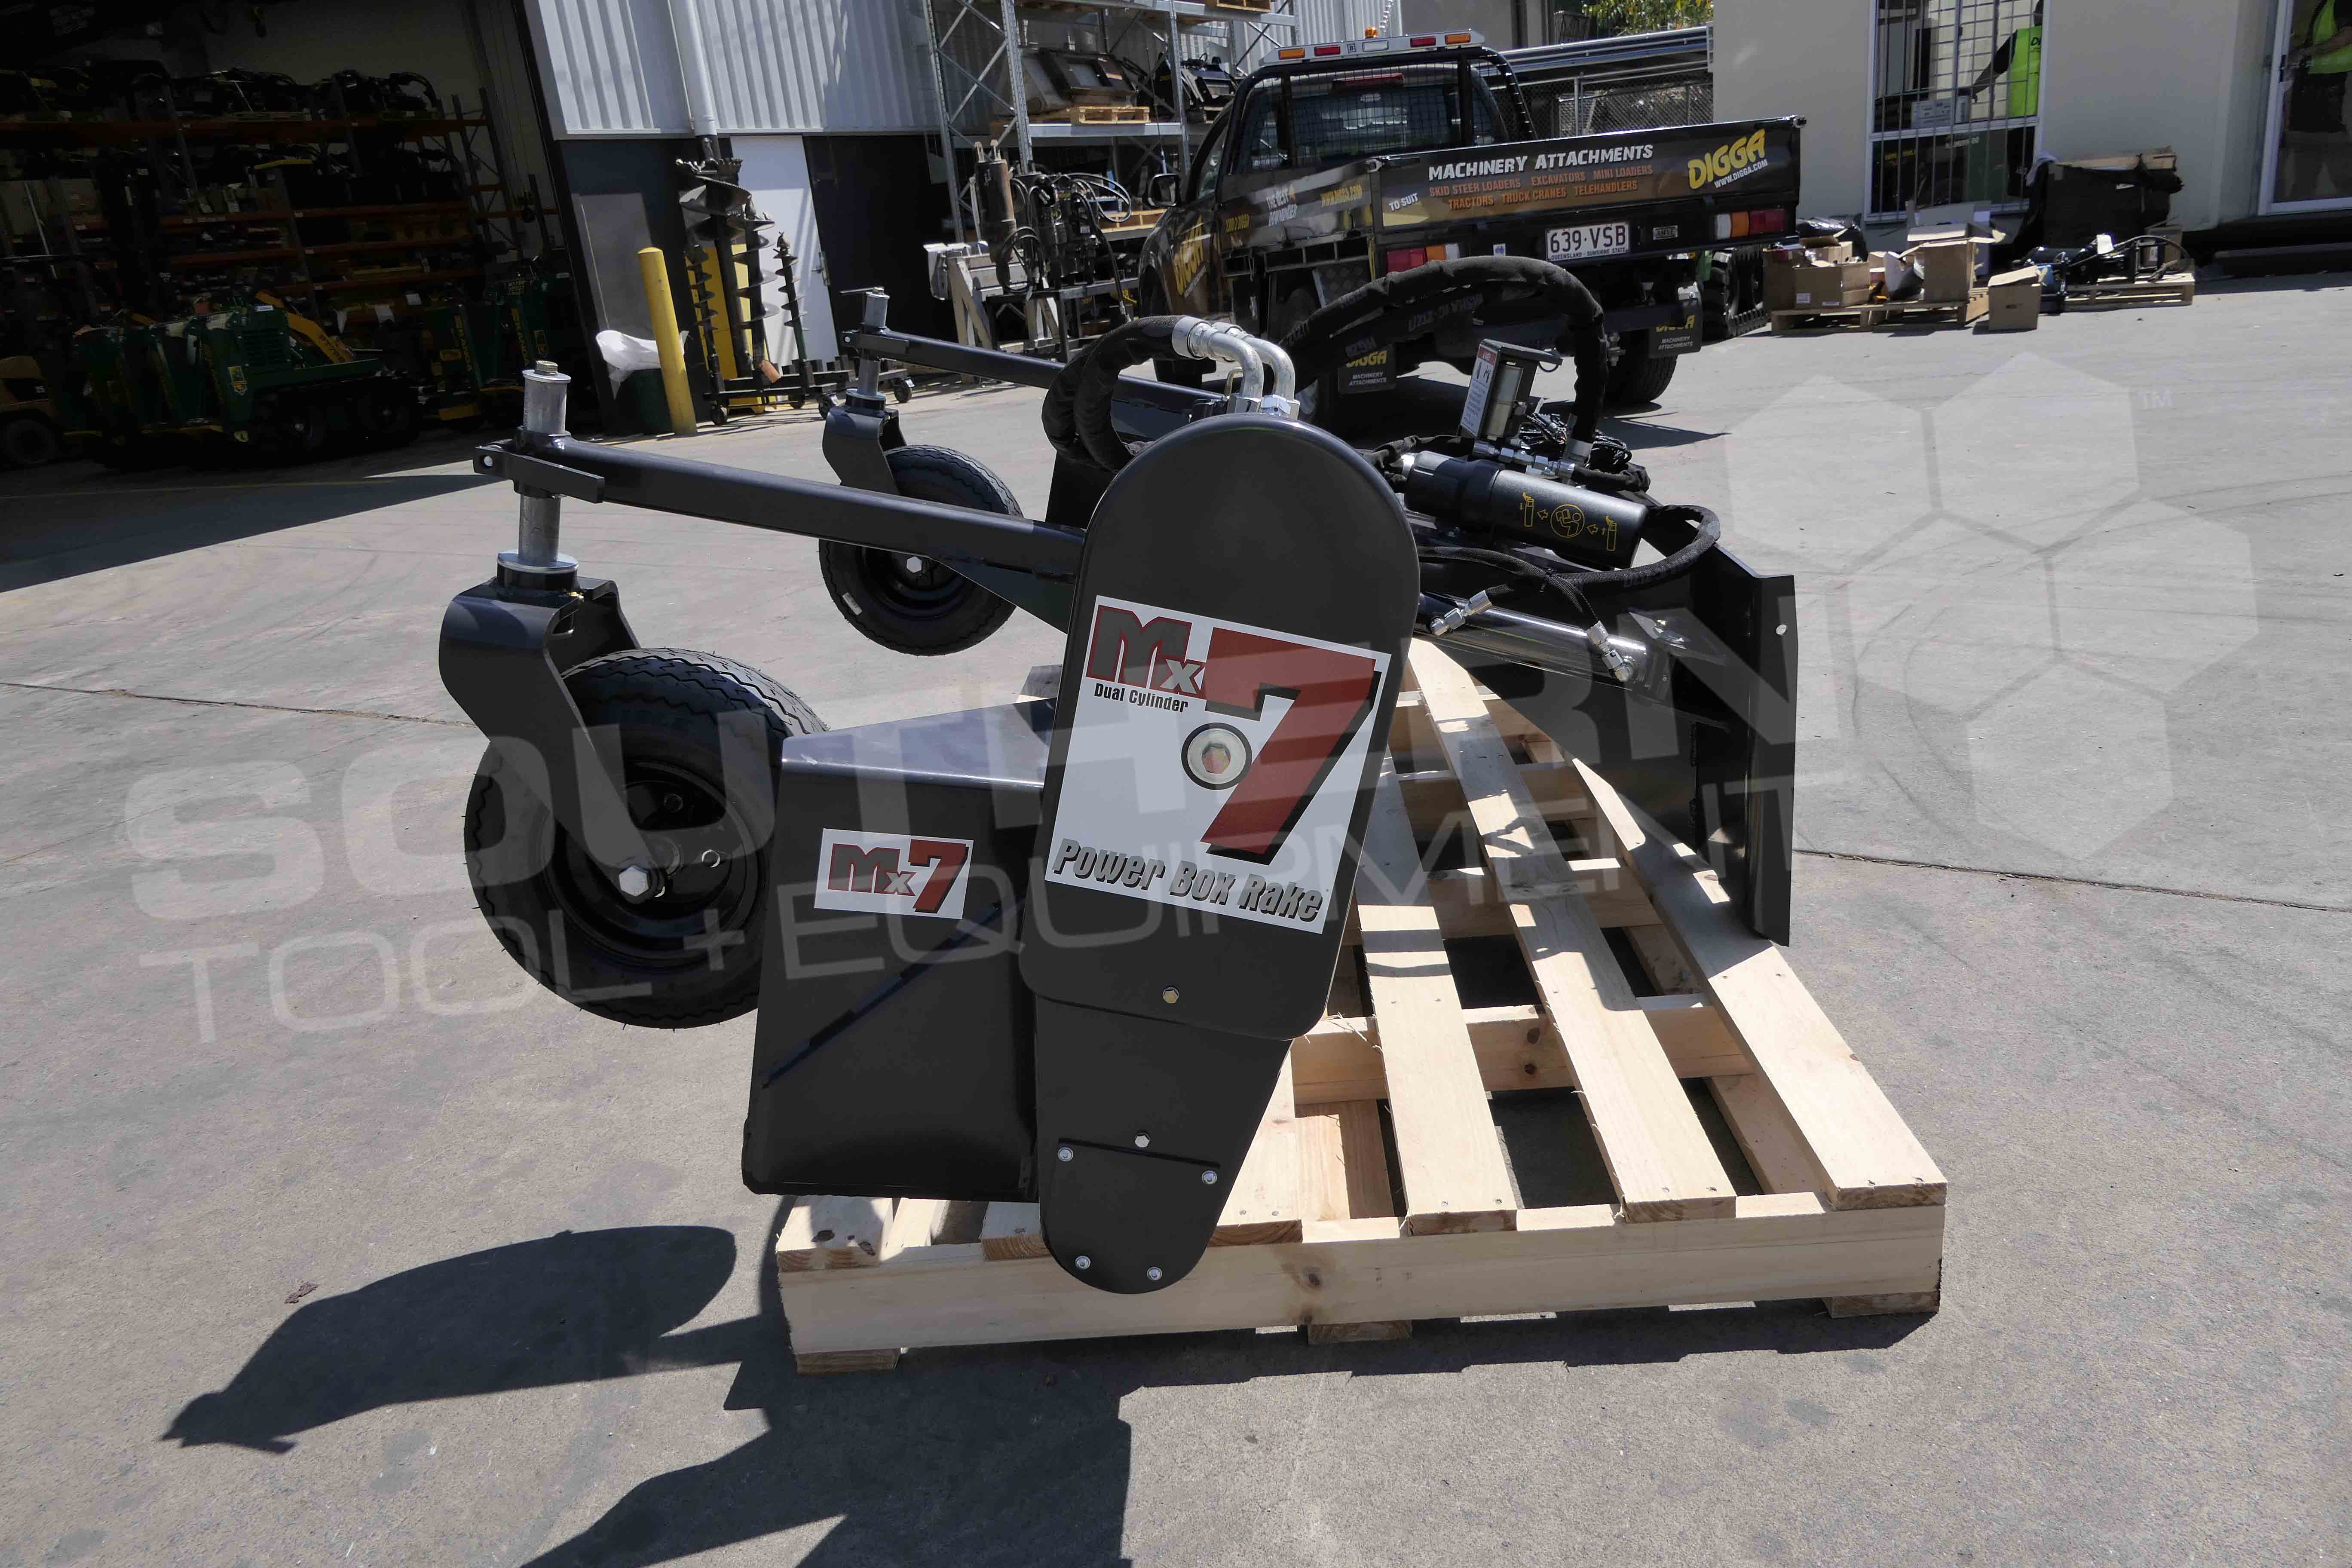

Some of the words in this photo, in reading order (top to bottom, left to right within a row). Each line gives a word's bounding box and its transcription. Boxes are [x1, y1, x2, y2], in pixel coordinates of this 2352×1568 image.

[1429, 156, 1528, 181] MACHINERY
[1534, 144, 1654, 170] ATTACHMENTS
[1688, 129, 1766, 189] DIGGA
[1714, 159, 1768, 188] WWW.DIGGA.COM
[1429, 185, 1450, 197] SKID
[1452, 182, 1479, 194] STEER
[1482, 178, 1521, 191] LOADERS
[1531, 172, 1586, 187] EXCAVATORS
[1593, 168, 1613, 180] MINI
[1615, 165, 1654, 178] LOADERS
[1448, 195, 1494, 210] TRACTORS
[1501, 190, 1530, 204] TRUCK
[1533, 185, 1568, 200] CRANES
[1574, 179, 1638, 196] TELEHANDLERS
[1389, 202, 1400, 212] TO
[1401, 193, 1418, 207] SUIT
[1352, 371, 1383, 380] MACHINERY
[1093, 683, 1125, 702] Dual
[1128, 689, 1189, 714] Cylinder
[1052, 837, 1167, 891] Power
[1237, 873, 1324, 922] Rake
